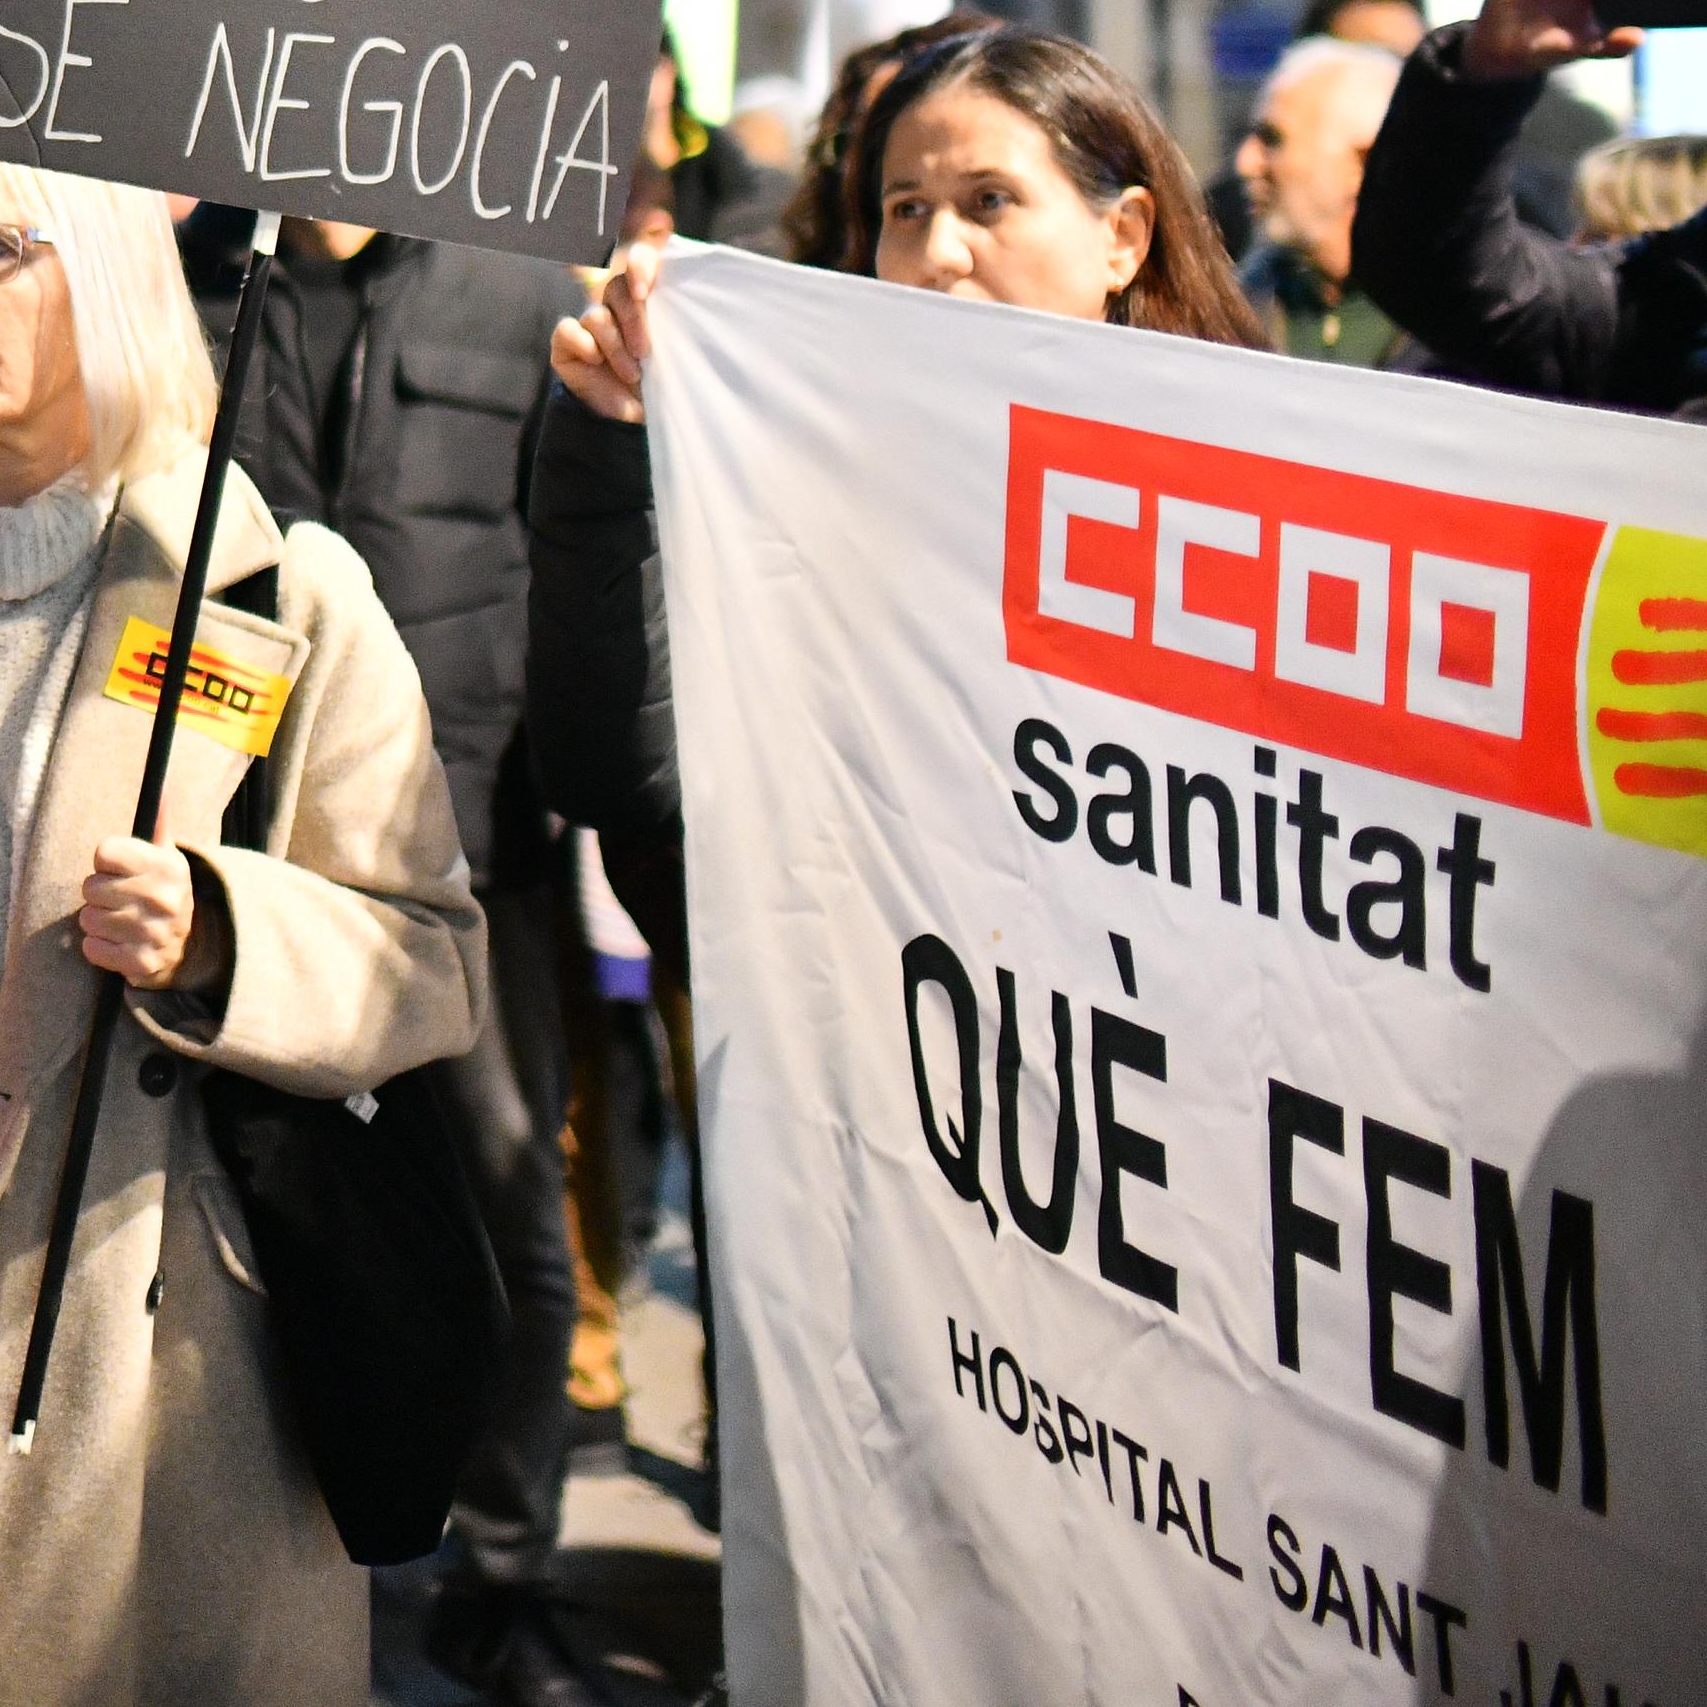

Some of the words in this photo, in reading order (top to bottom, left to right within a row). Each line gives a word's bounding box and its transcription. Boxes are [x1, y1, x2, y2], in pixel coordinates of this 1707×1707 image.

[184, 21, 620, 236] NEGOCIA
[1036, 467, 1531, 741] CCOO
[1011, 717, 1497, 994] sanitat
[901, 930, 1180, 1315] QUÈ
[1266, 1076, 1608, 1516] FEM
[946, 1315, 1245, 1583] HOSPITAL
[1265, 1512, 1468, 1697] SANT
